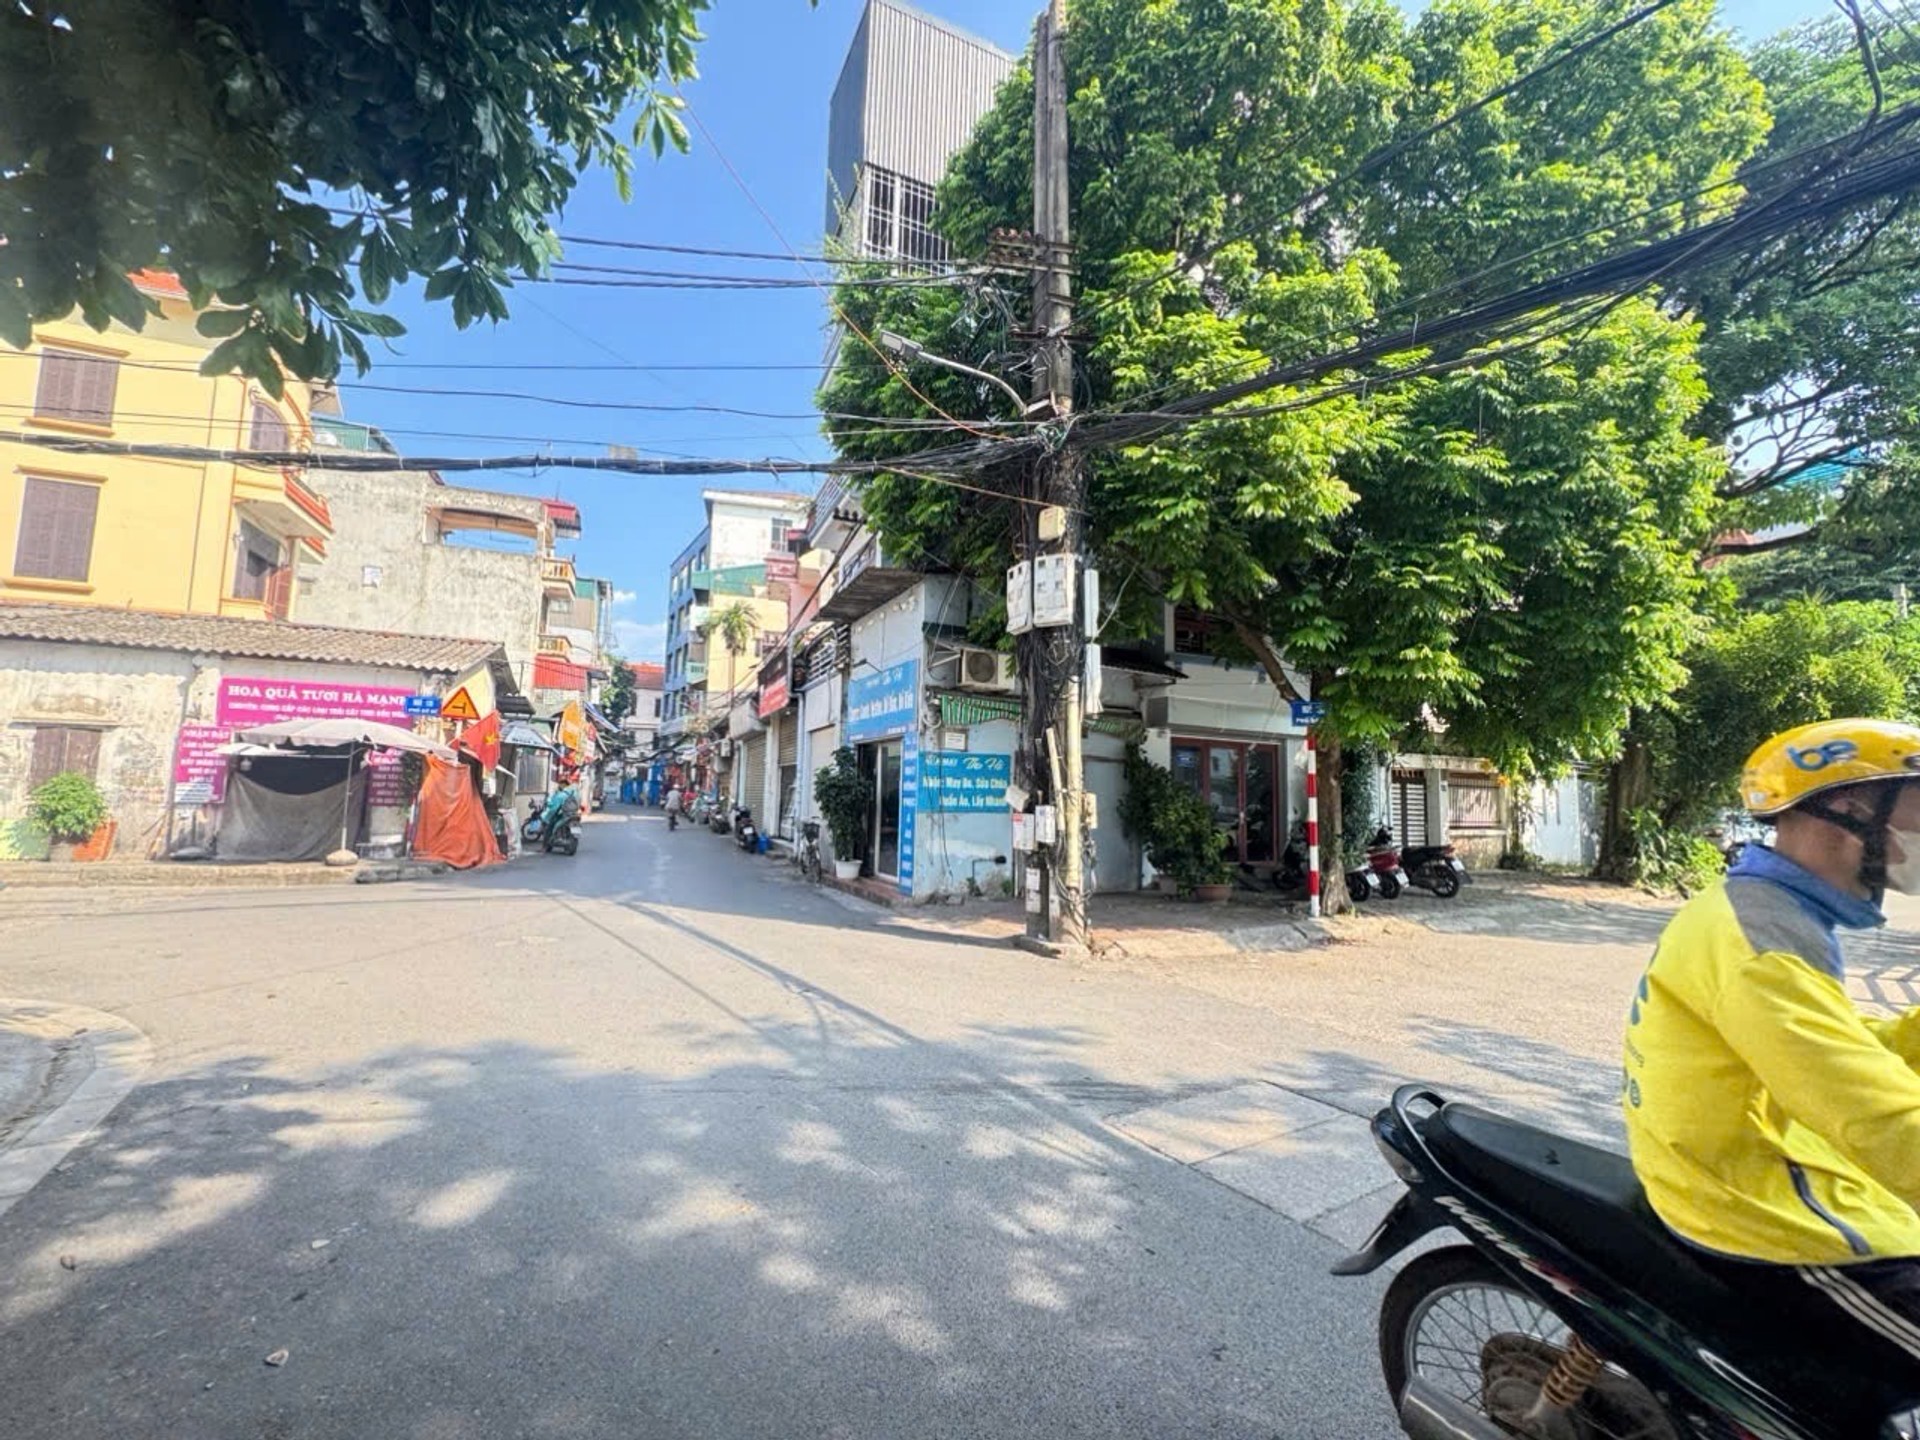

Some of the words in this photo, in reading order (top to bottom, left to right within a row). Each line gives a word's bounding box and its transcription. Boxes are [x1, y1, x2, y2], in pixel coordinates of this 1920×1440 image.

[228, 685, 262, 698] HOA
[265, 684, 298, 700] QUẢ
[302, 689, 340, 702] TƯƠI
[343, 690, 364, 704] HÀ
[1787, 740, 1857, 771] be
